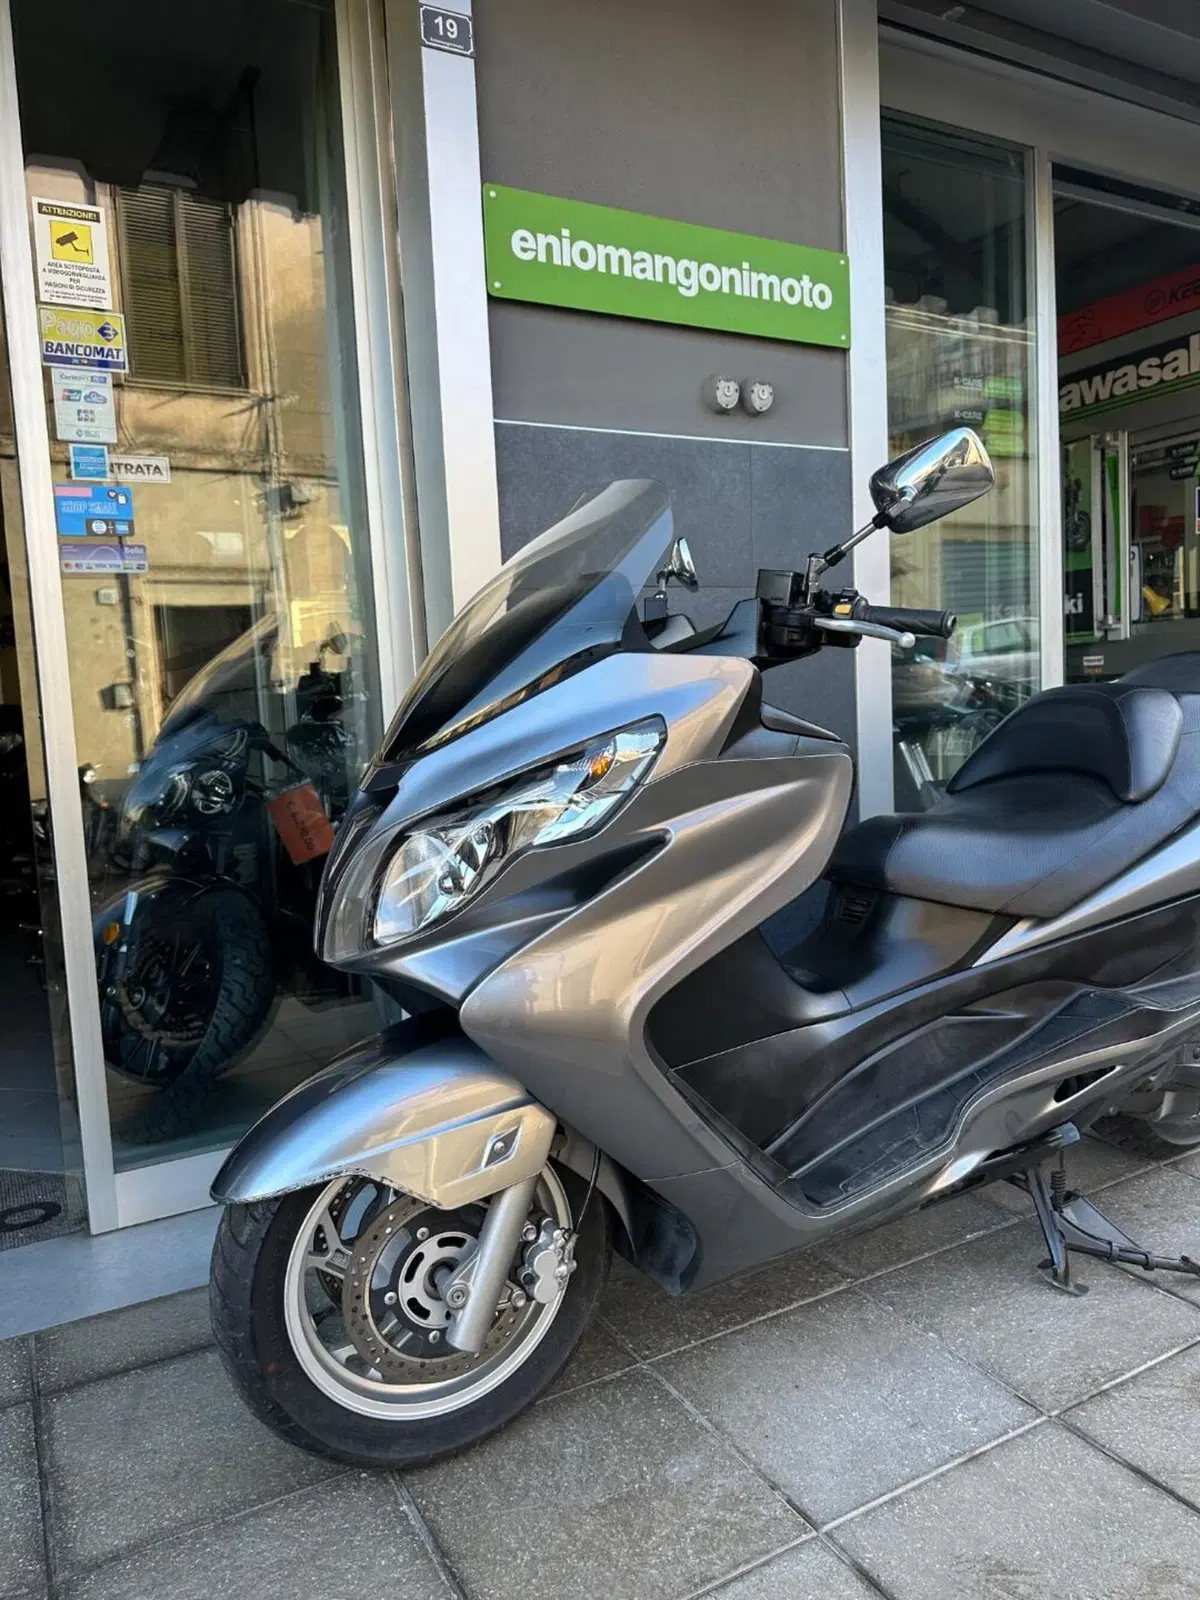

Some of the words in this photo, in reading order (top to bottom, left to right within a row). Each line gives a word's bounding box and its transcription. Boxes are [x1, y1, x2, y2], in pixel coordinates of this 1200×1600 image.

[434, 16, 458, 39] 19
[42, 205, 97, 220] ATTENZIONE!
[511, 228, 833, 310] eniomangonimoto
[42, 311, 96, 342] Pago
[45, 341, 123, 360] BANCOMAT
